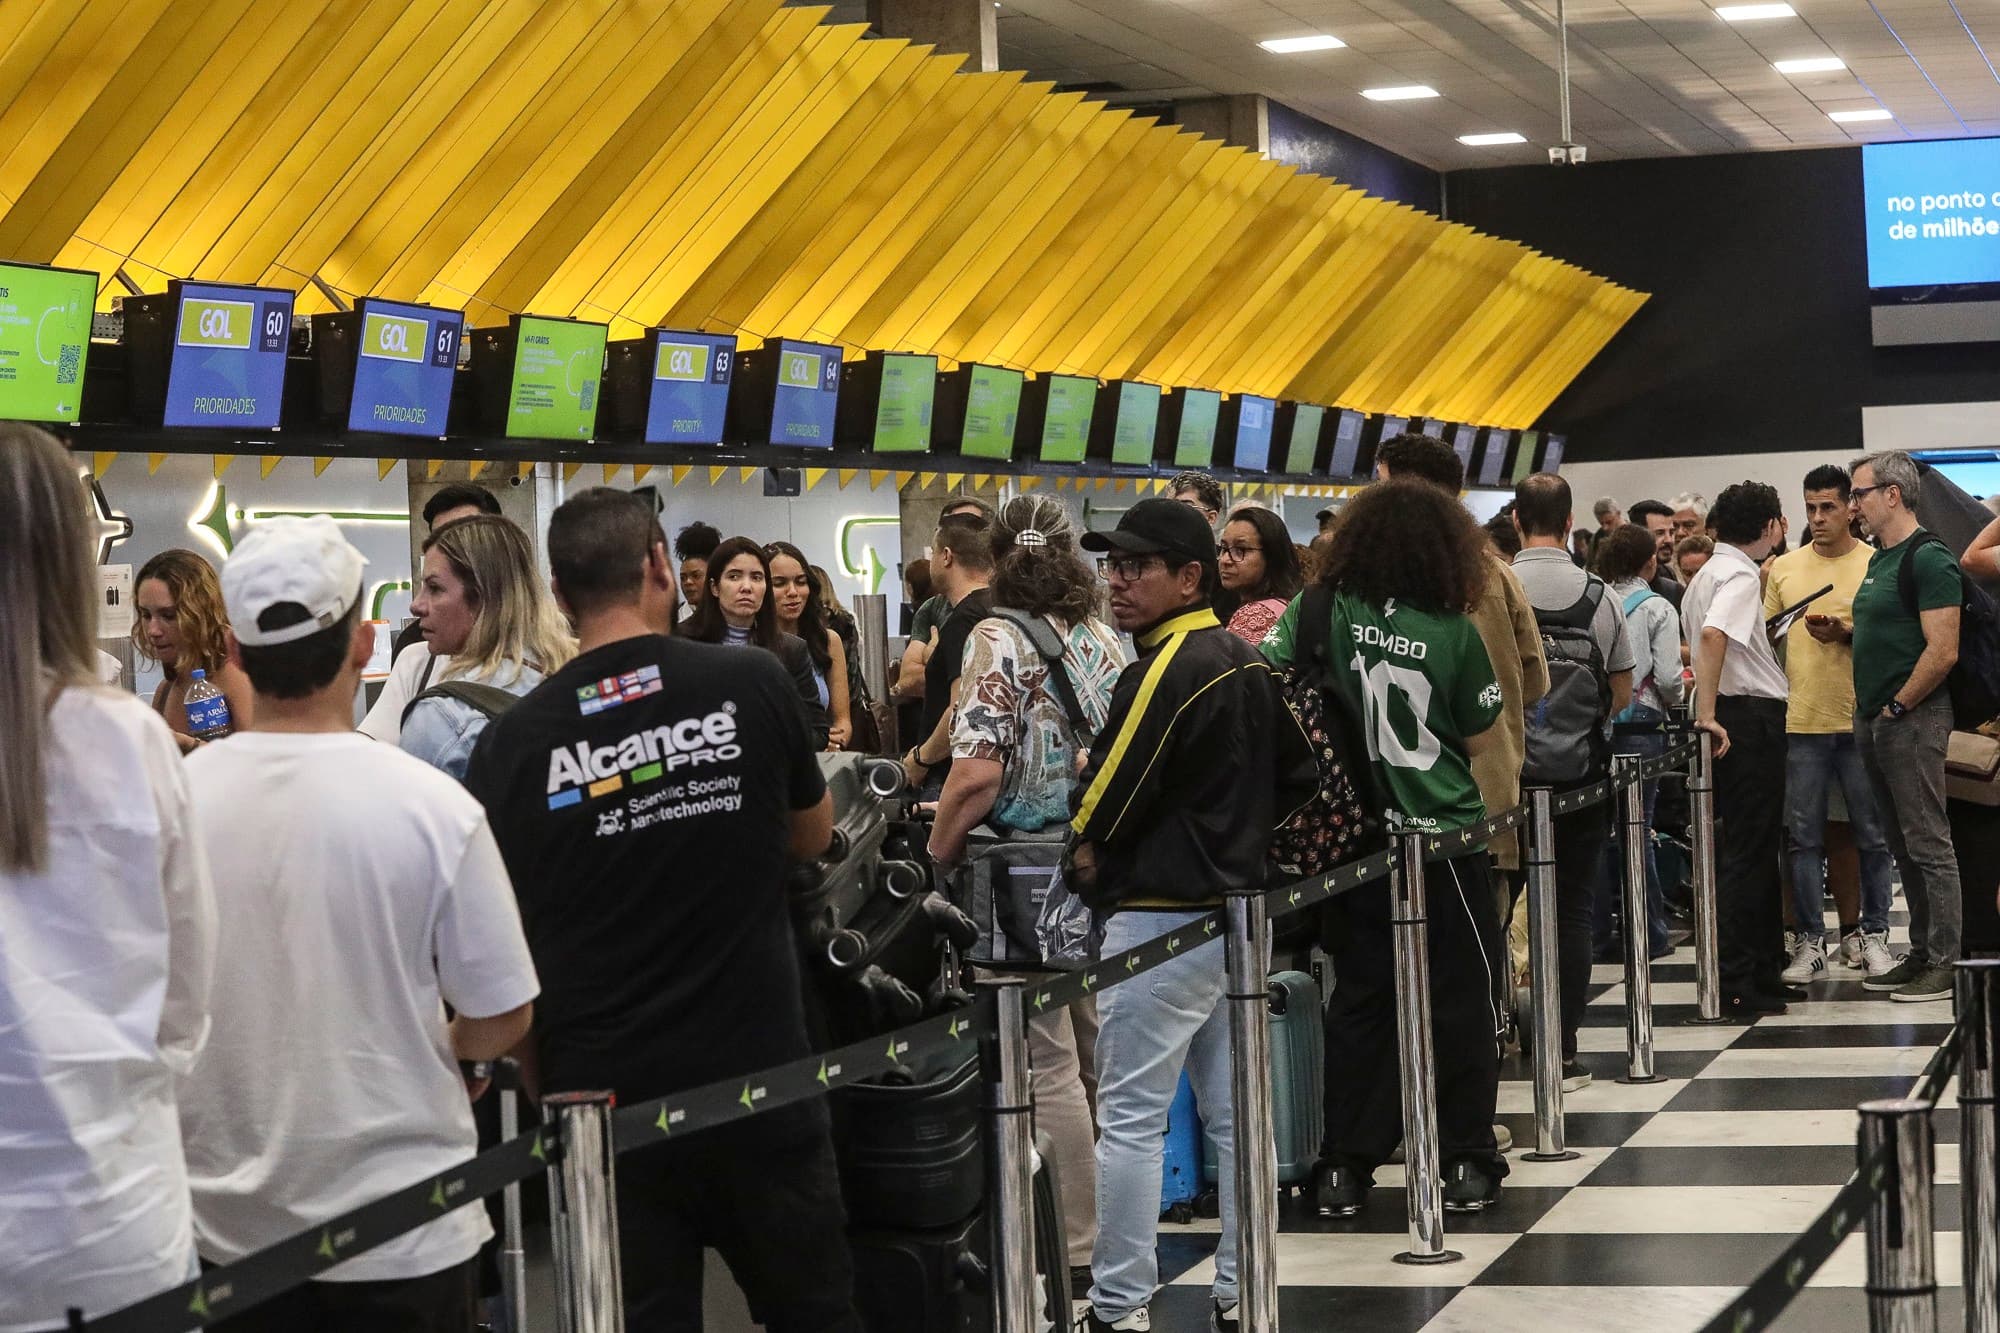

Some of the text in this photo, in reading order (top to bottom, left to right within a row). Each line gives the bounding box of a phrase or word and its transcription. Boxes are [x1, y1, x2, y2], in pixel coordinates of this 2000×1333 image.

[1887, 196, 1915, 212] no
[1921, 191, 1986, 215] ponto
[1888, 220, 1917, 240] de
[199, 308, 232, 339] GOL
[266, 311, 283, 336] 60
[380, 323, 408, 352] GOL
[438, 329, 453, 353] 61
[670, 350, 693, 374] GOL
[716, 352, 729, 372] 63
[790, 358, 809, 381] GOL
[826, 362, 837, 381] 64
[193, 397, 257, 415] PRIORIDADES
[373, 404, 427, 424] PRIORIDADES
[672, 419, 702, 433] PRIORITY
[1351, 623, 1427, 661] BOMBO
[1351, 650, 1441, 771] 10
[546, 711, 737, 794] Alcance
[666, 744, 742, 772] PRO
[687, 775, 741, 797] Society
